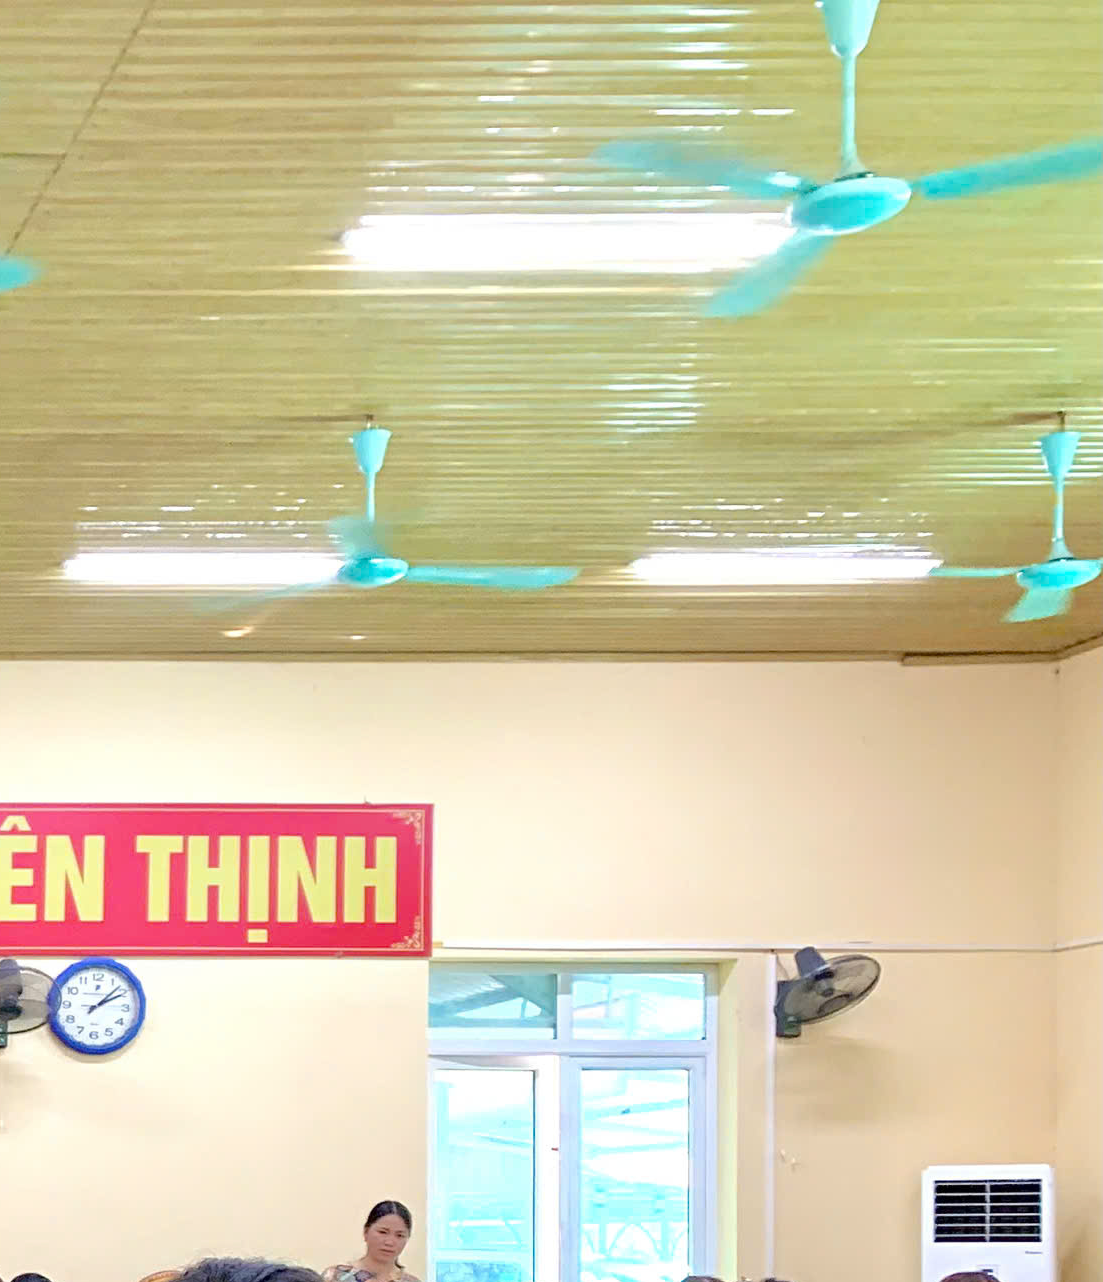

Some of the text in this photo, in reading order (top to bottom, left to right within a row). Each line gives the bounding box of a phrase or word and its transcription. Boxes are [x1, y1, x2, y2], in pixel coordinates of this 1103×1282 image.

[136, 834, 398, 944] THỊNH
[67, 986, 79, 996] 10
[121, 1003, 130, 1013] 3
[65, 1014, 75, 1024] 8
[114, 1017, 125, 1027] 4
[76, 1025, 85, 1035] 7
[104, 1027, 114, 1037] 5
[89, 1031, 99, 1040] 6
